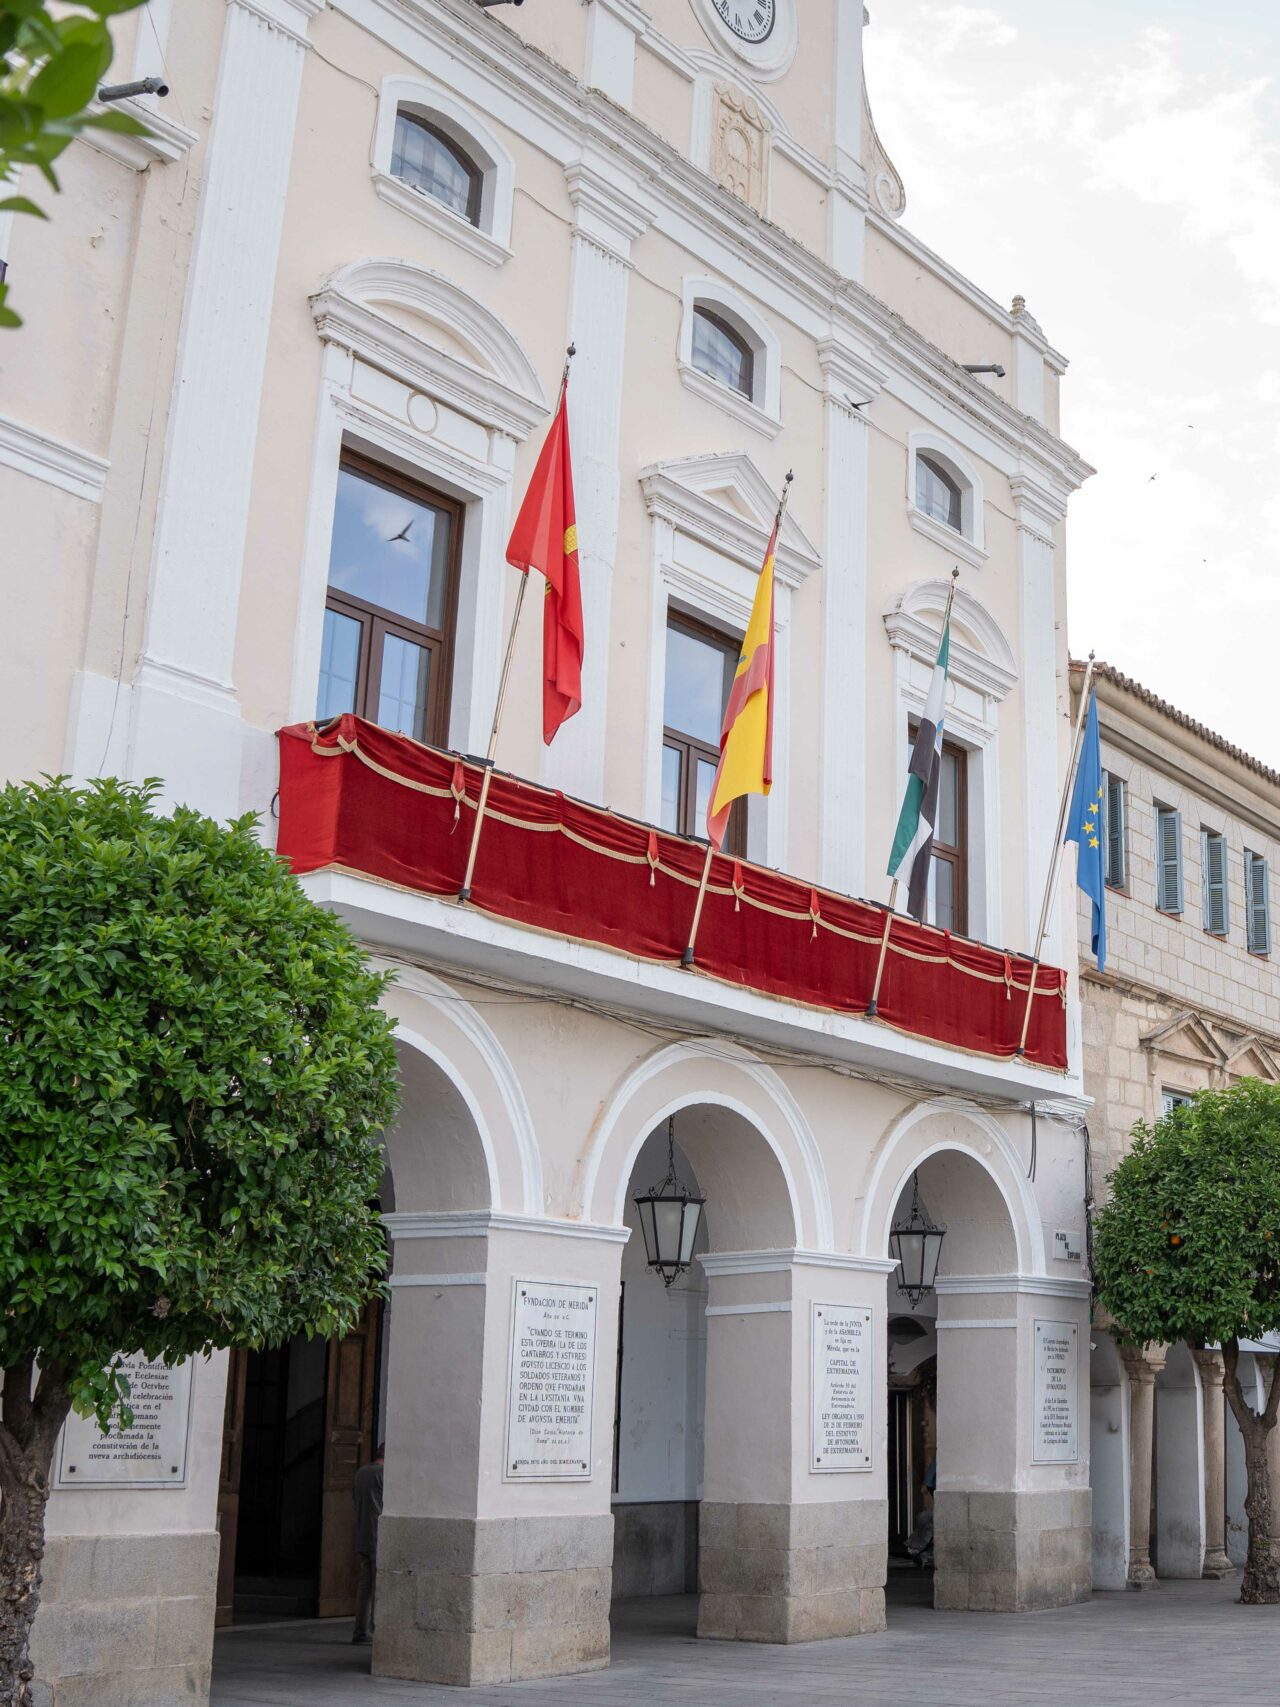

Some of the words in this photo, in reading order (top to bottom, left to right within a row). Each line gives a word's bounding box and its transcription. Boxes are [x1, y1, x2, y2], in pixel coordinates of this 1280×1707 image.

[559, 1300, 566, 1308] DE
[522, 1339, 533, 1347] ESTA
[521, 1350, 553, 1358] CANTABROS
[577, 1363, 586, 1371] LOS
[520, 1371, 550, 1380] SOLDADOS
[552, 1372, 580, 1381] VETERANOS
[519, 1382, 543, 1390] ORDENO
[545, 1383, 556, 1392] QVE
[542, 1394, 570, 1402] LVSITANIA
[574, 1394, 584, 1402] VNA
[519, 1404, 539, 1412] CIVDAD
